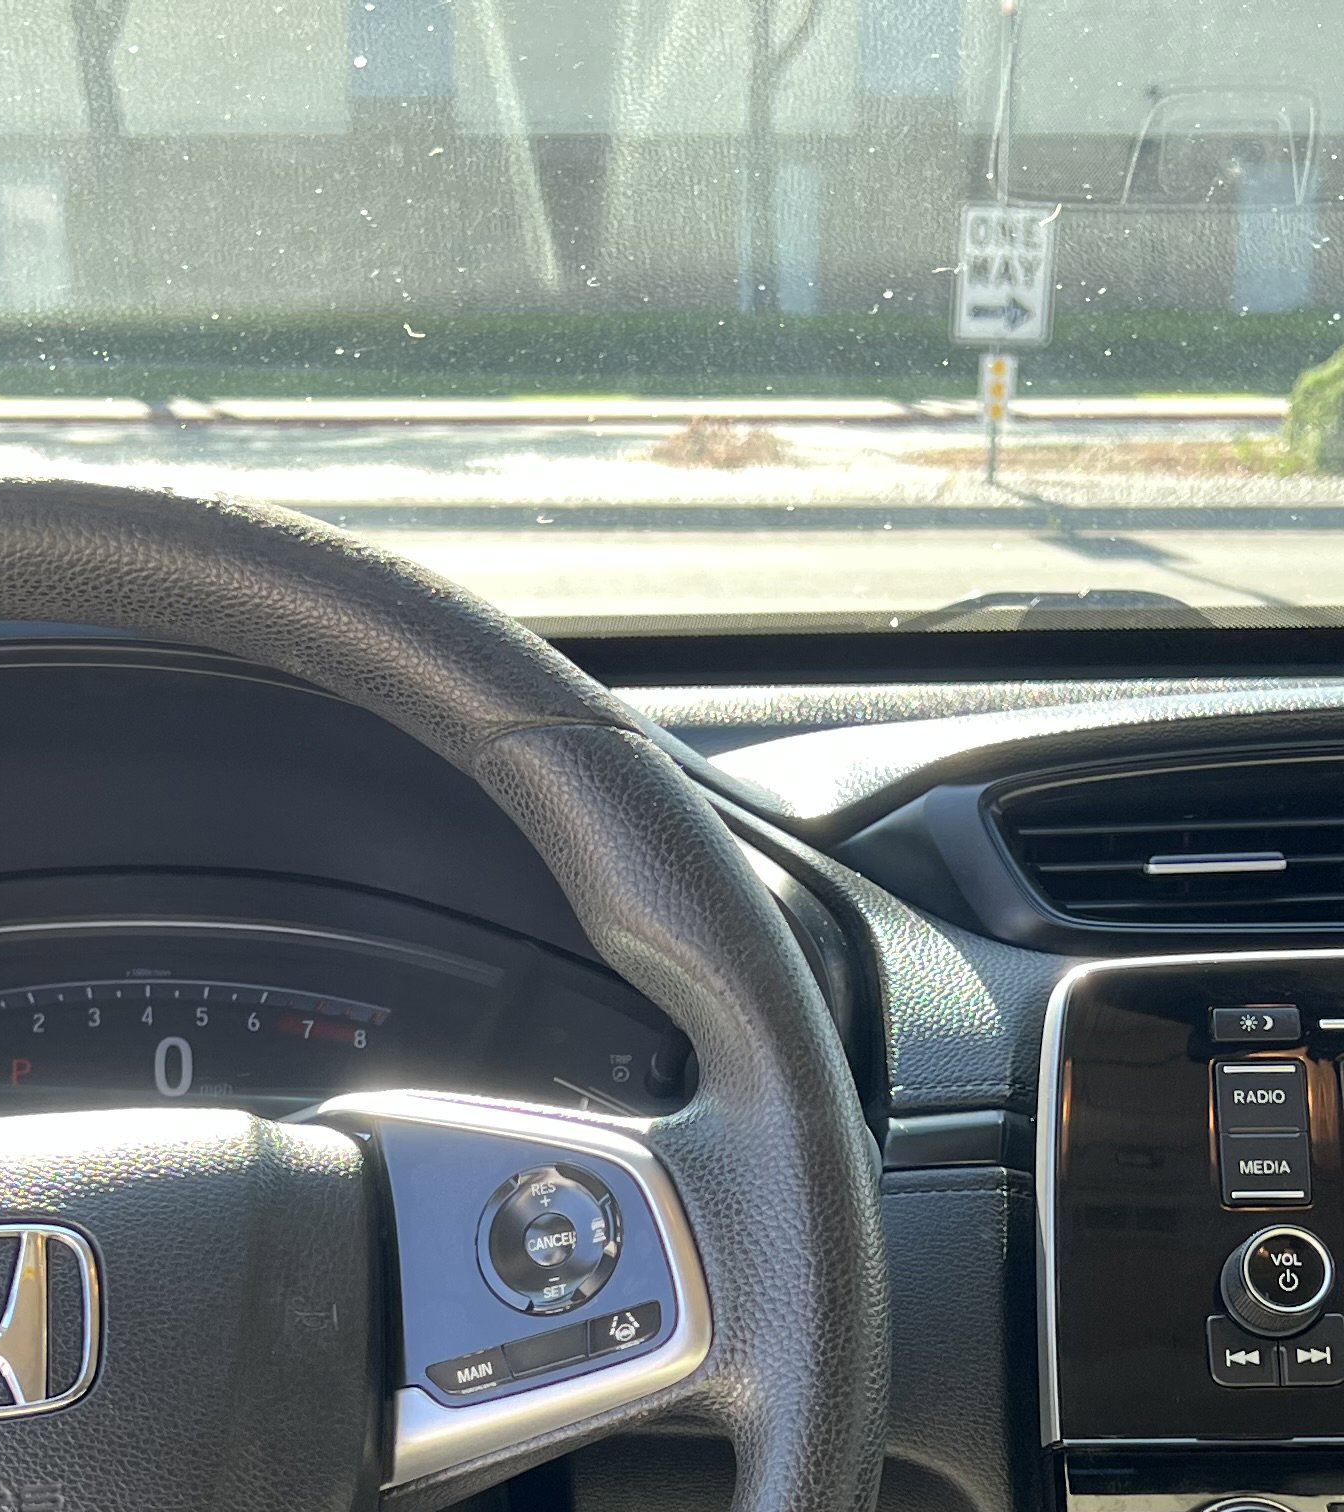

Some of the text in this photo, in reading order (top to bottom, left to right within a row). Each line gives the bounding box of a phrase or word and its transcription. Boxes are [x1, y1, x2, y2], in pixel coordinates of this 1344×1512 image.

[969, 214, 1046, 248] ONE
[969, 256, 1045, 288] WAY
[32, 1014, 45, 1033] 2
[88, 1008, 101, 1027] 3
[141, 1007, 154, 1026] 4
[196, 1007, 208, 1026] 5
[248, 1013, 260, 1032] 6
[302, 1021, 314, 1039] 7
[354, 1030, 367, 1049] 8
[11, 1059, 32, 1085] P
[155, 1037, 193, 1097] 0
[1234, 1090, 1286, 1105] RADIO
[1239, 1160, 1290, 1175] MEDIA
[531, 1181, 556, 1197] RES
[527, 1230, 576, 1251] CANCEL
[1271, 1253, 1302, 1267] VOL
[543, 1283, 567, 1299] SET
[456, 1361, 493, 1384] MAIN
